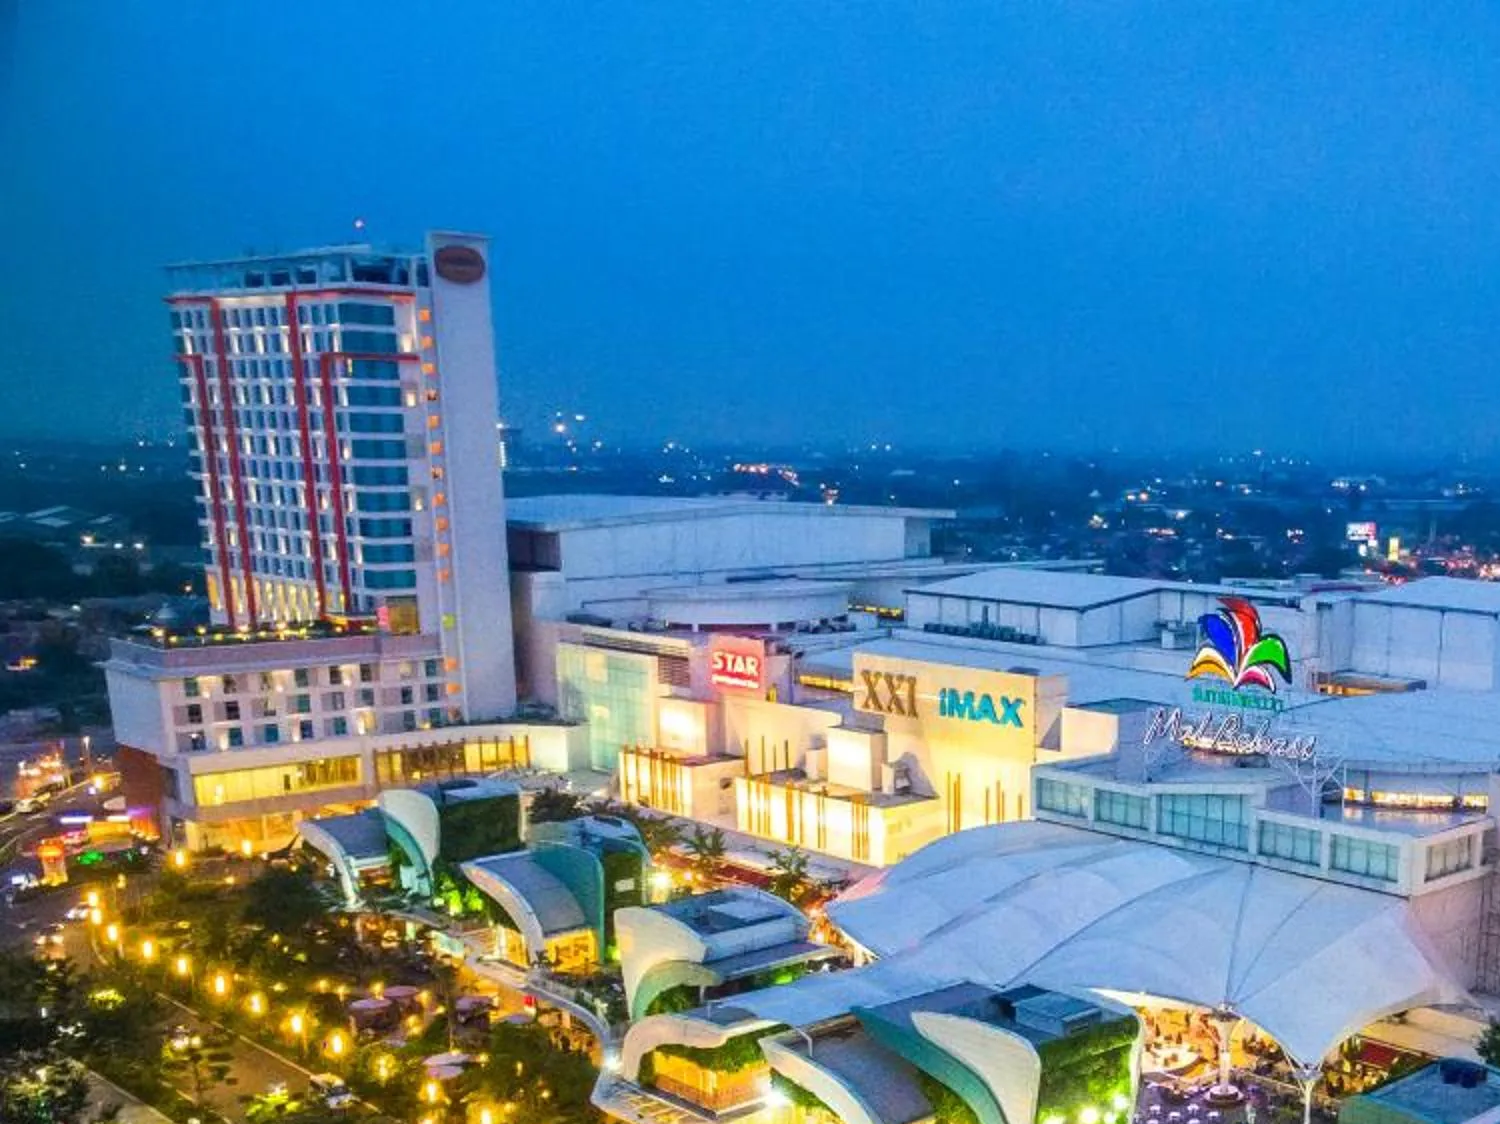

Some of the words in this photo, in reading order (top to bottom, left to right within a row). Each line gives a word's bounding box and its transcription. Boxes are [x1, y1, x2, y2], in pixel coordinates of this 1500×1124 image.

[711, 651, 759, 676] STAR
[861, 669, 918, 719] XXI
[938, 687, 1024, 727] IMAX
